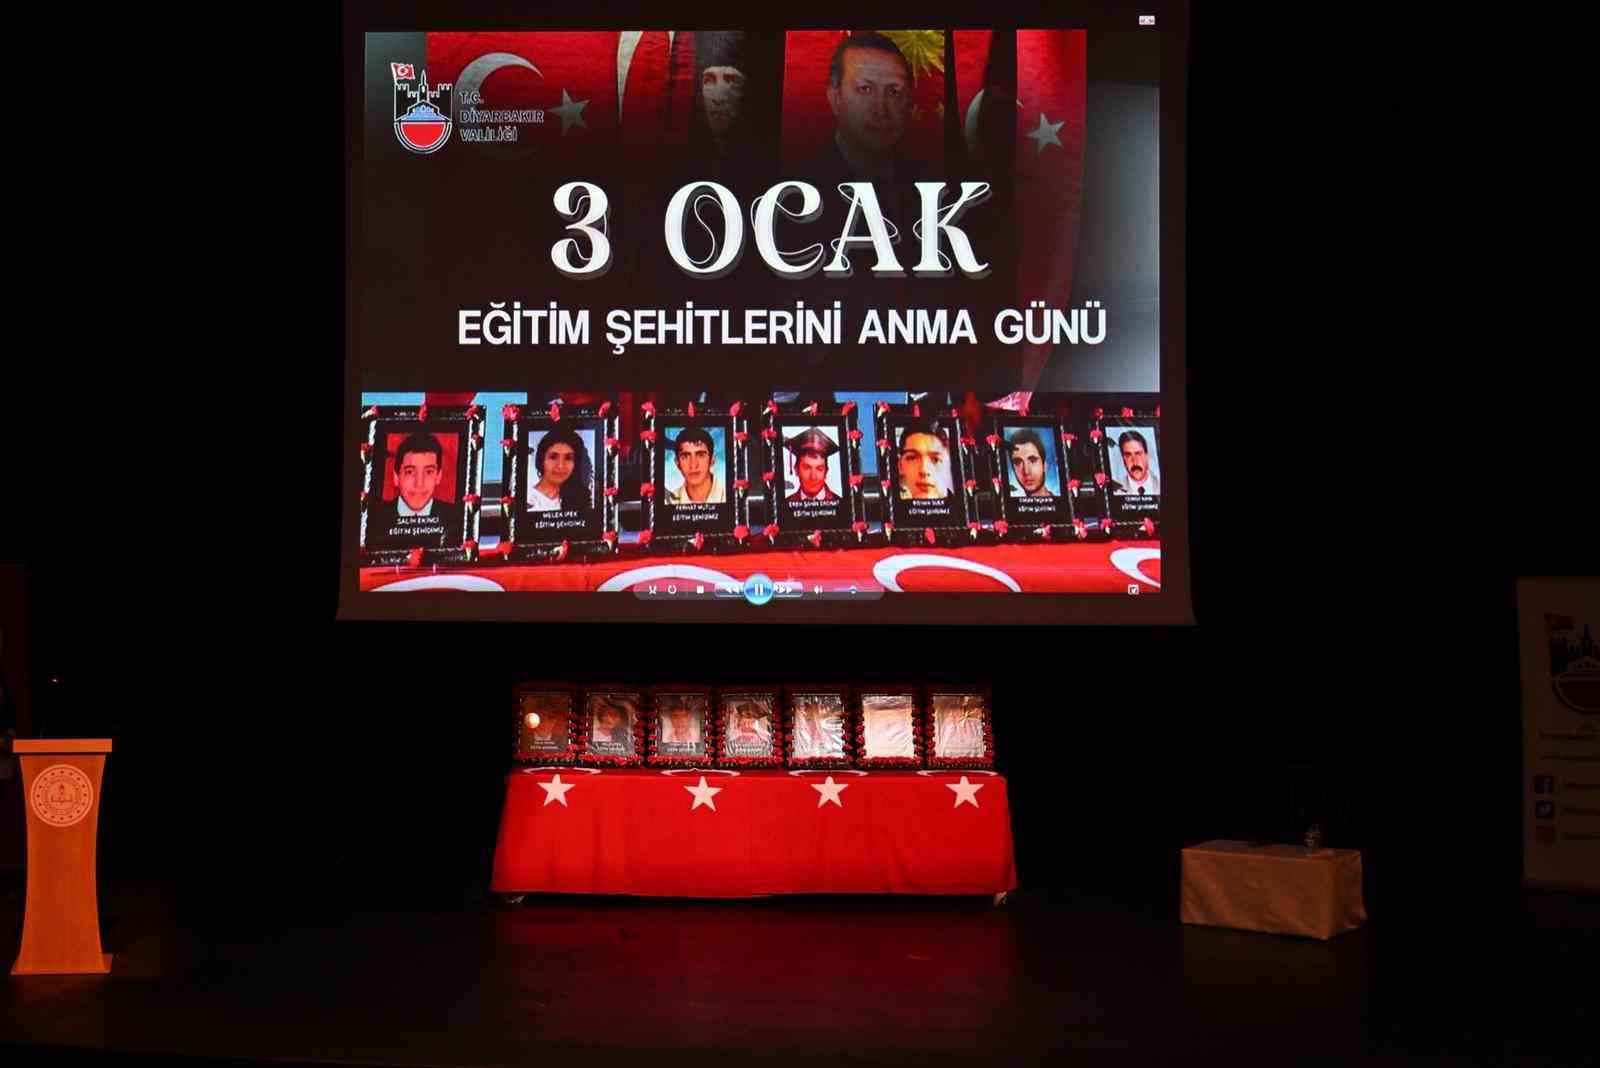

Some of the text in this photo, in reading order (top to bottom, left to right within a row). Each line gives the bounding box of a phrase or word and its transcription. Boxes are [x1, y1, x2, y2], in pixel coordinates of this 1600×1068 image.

[459, 91, 485, 105] T.C.
[551, 180, 991, 274] 3 OCAK
[458, 301, 1108, 355] EĞİTİM ŞEHİTLERİNİ ANMA GÜNÜ
